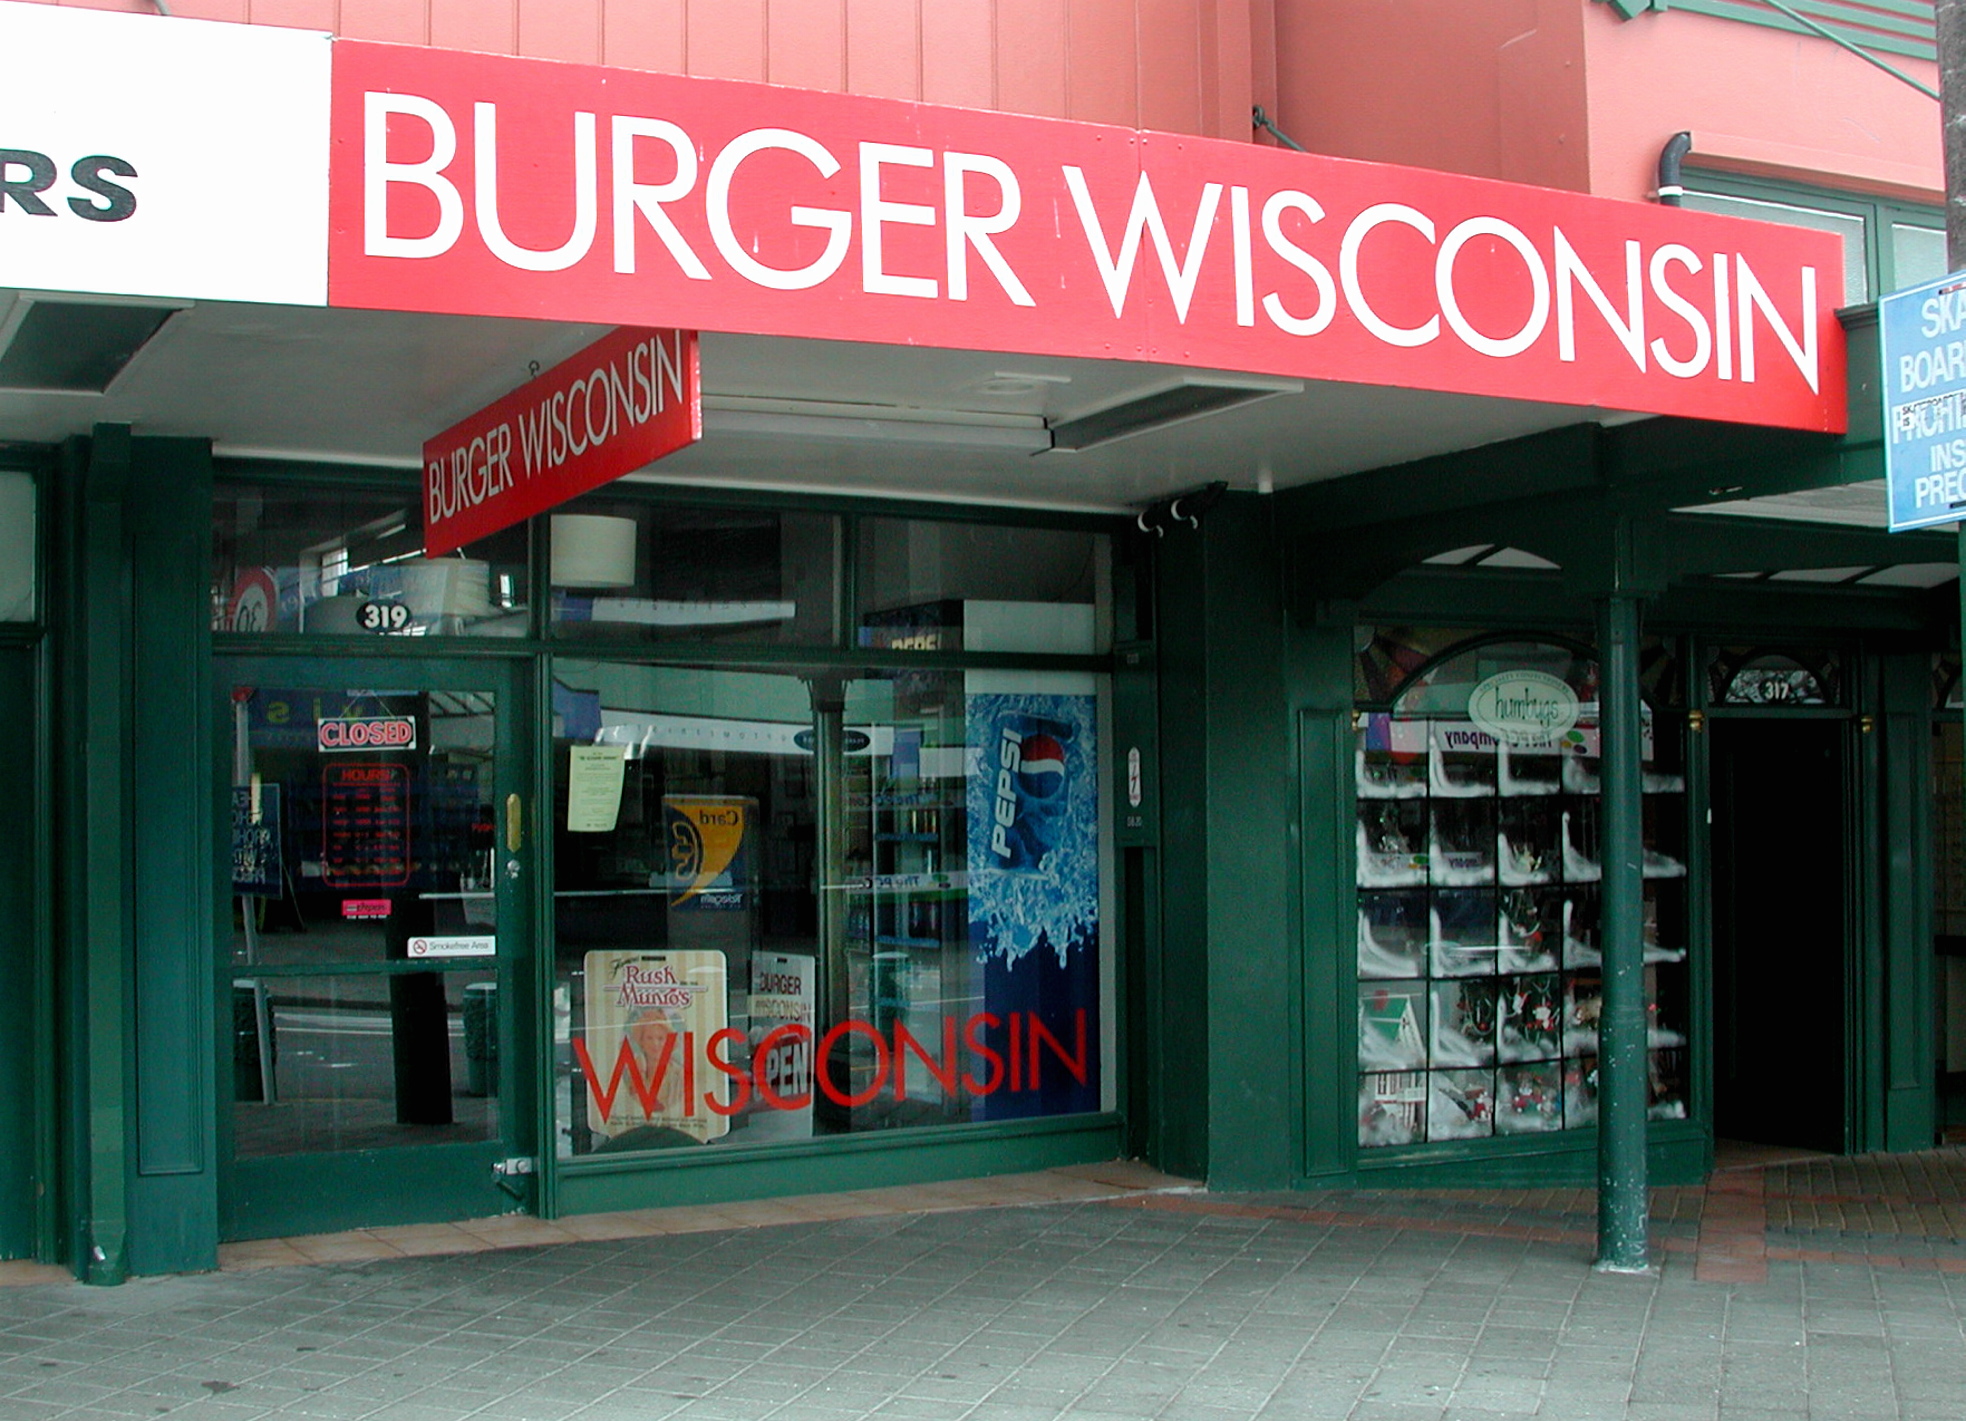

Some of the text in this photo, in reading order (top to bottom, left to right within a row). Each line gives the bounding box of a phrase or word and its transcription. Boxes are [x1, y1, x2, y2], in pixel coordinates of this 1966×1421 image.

[0, 148, 138, 222] RS
[364, 90, 1819, 396] BURGER WISCONSIN
[1900, 341, 1966, 393] BOAR
[429, 329, 683, 524] BURGER WISCONSIN
[364, 604, 407, 629] 319
[1495, 686, 1559, 728] humbugs
[1765, 681, 1789, 700] 317
[319, 722, 412, 746] CLOSED
[342, 769, 391, 780] HOURS
[991, 728, 1022, 859] PEPSI
[430, 940, 489, 951] Smokefree Area
[616, 982, 691, 1006] Munro's
[626, 965, 678, 984] Rush
[572, 1008, 1087, 1125] WISCONSIN
[755, 1040, 809, 1099] PEN
